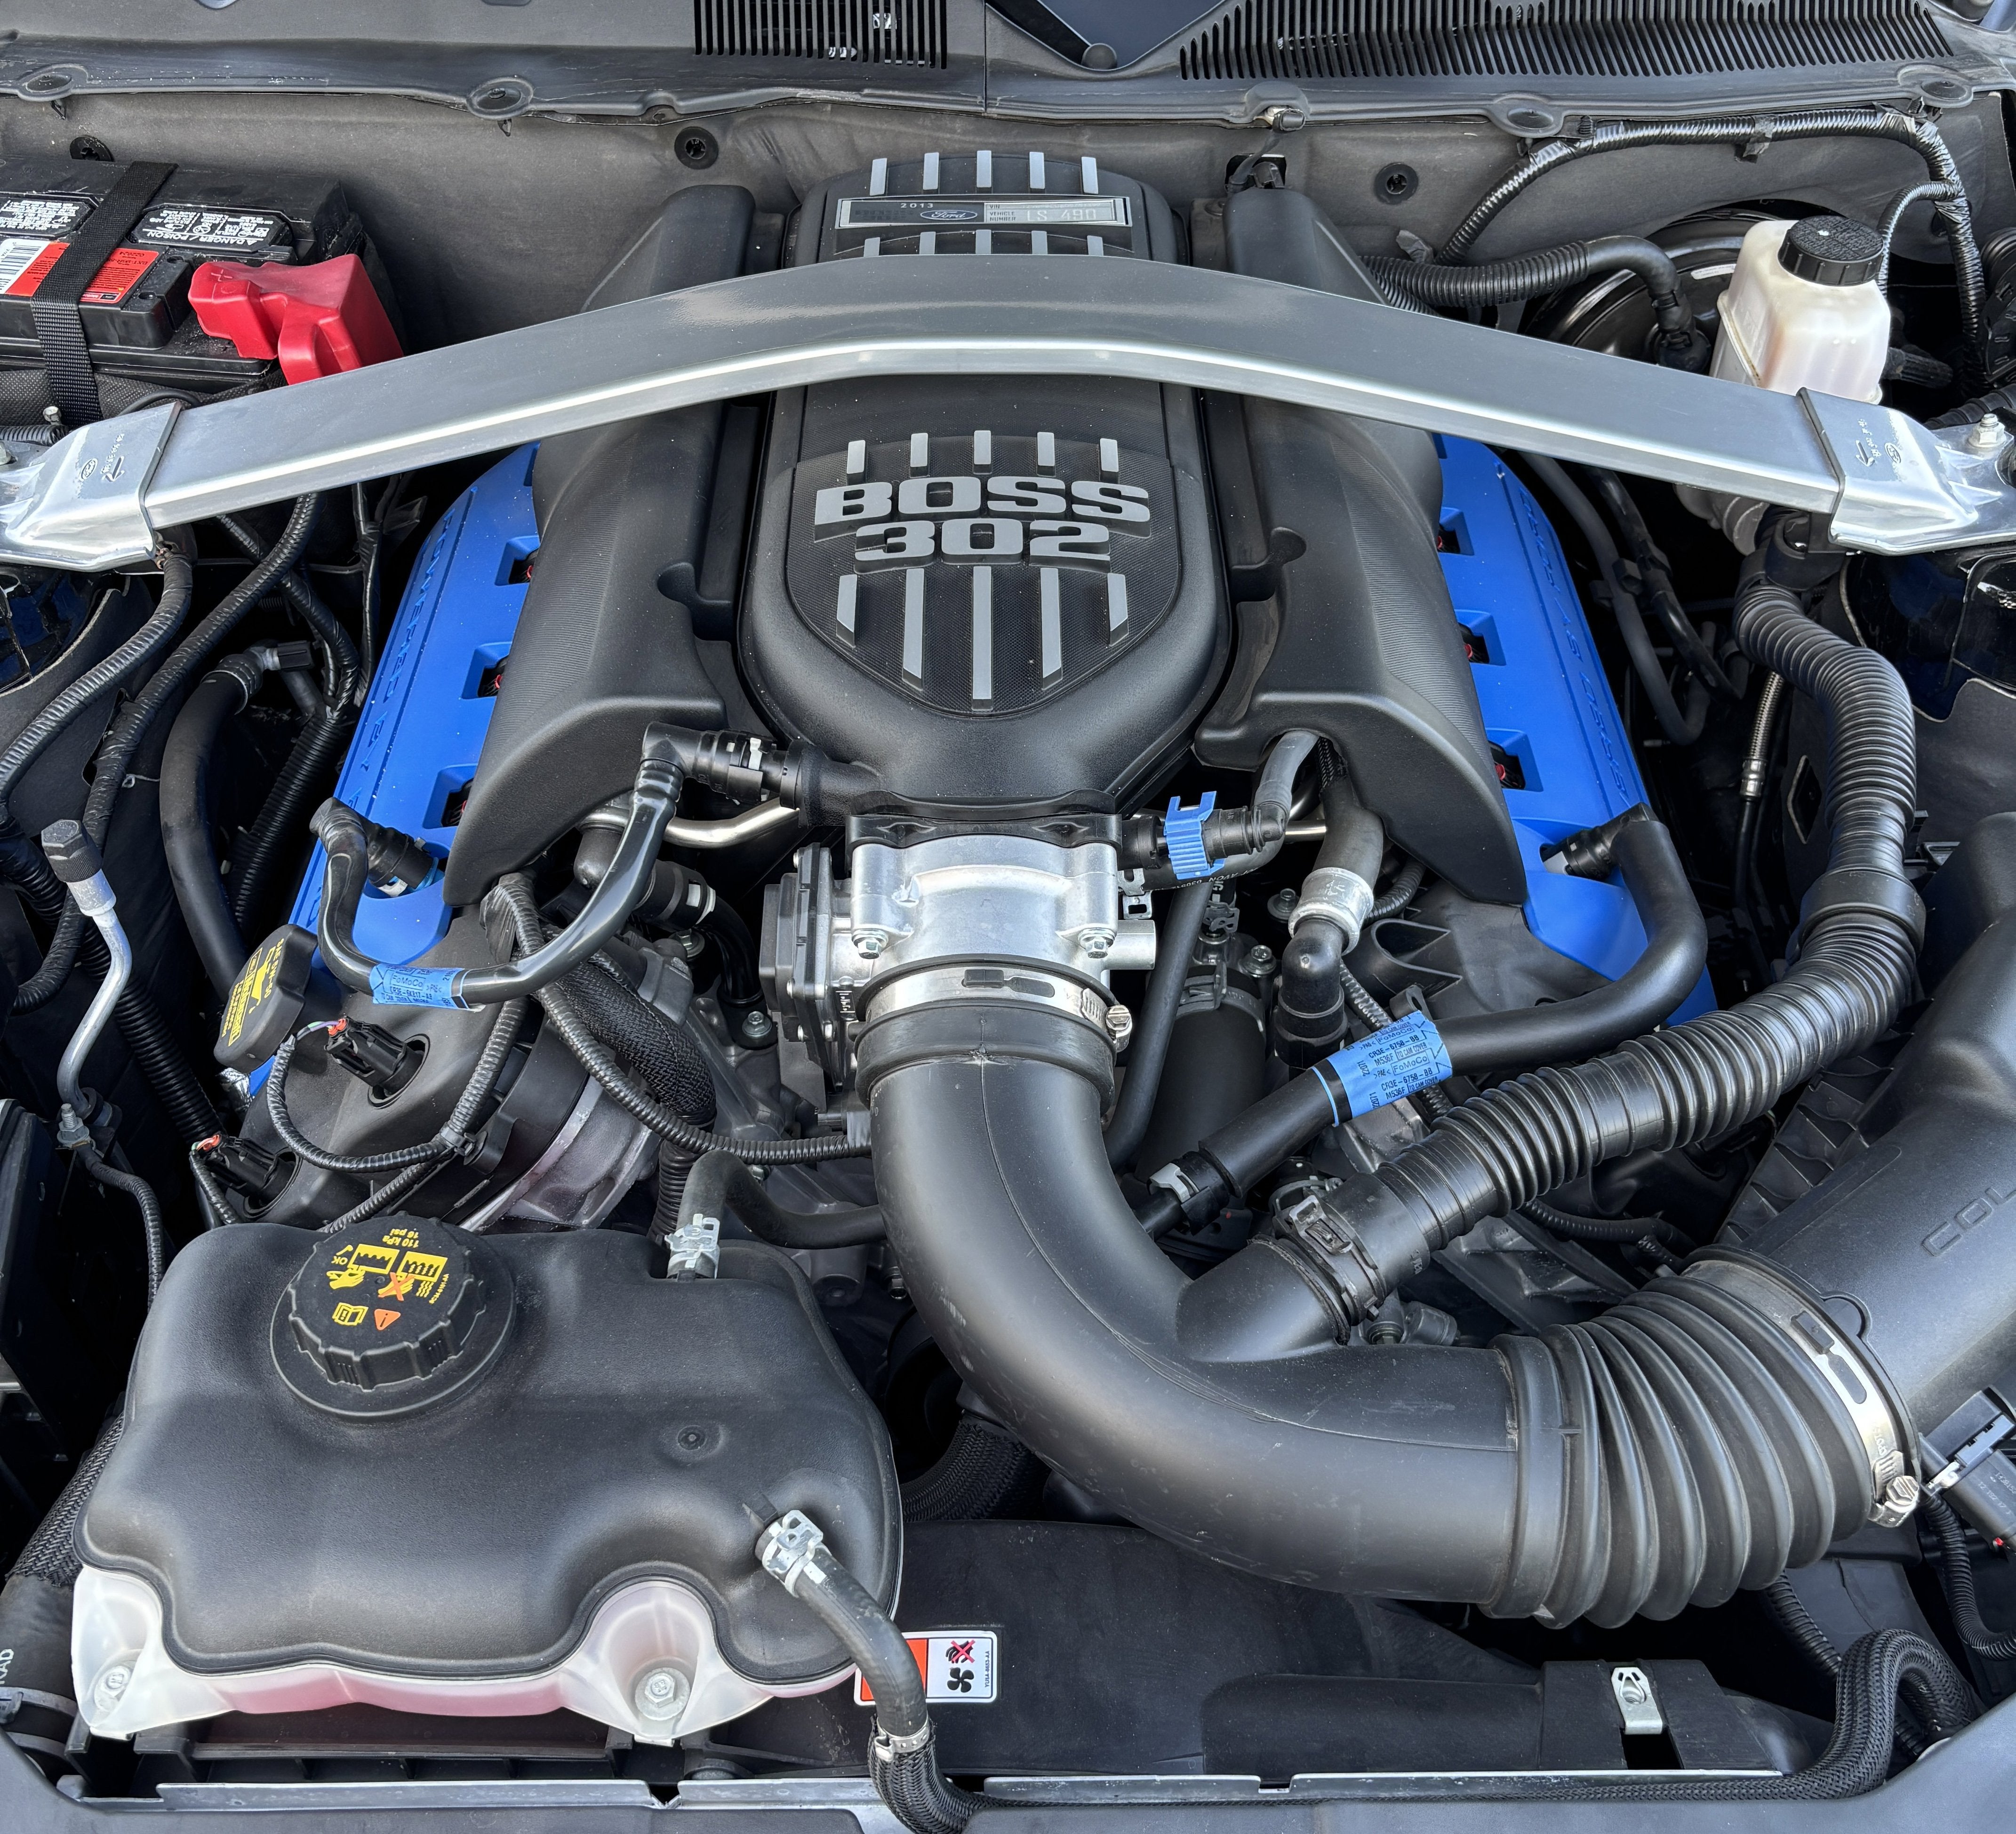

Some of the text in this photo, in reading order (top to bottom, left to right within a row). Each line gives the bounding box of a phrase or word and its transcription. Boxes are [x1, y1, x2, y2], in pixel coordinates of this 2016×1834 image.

[929, 210, 967, 219] Ford
[1027, 210, 1047, 221] LS
[147, 231, 189, 241] POISON
[200, 236, 246, 245] DANGER
[814, 476, 1151, 528] BOSS
[855, 518, 1111, 563] 302
[1208, 873, 1238, 882] AVON
[264, 938, 284, 999] SAE 5W-50
[392, 975, 423, 987] FoMoCo
[1397, 1021, 1411, 1030] COVER
[1377, 1027, 1412, 1042] FoMoCo
[1374, 1041, 1427, 1066] M536F TO CAM COVER
[1393, 1056, 1428, 1073] FoMoCo
[1385, 1087, 1405, 1100] M536F
[1415, 1081, 1424, 1089] CAM
[407, 1231, 419, 1239] 16
[382, 1235, 419, 1248] 110 kPa
[331, 1256, 348, 1265] OK
